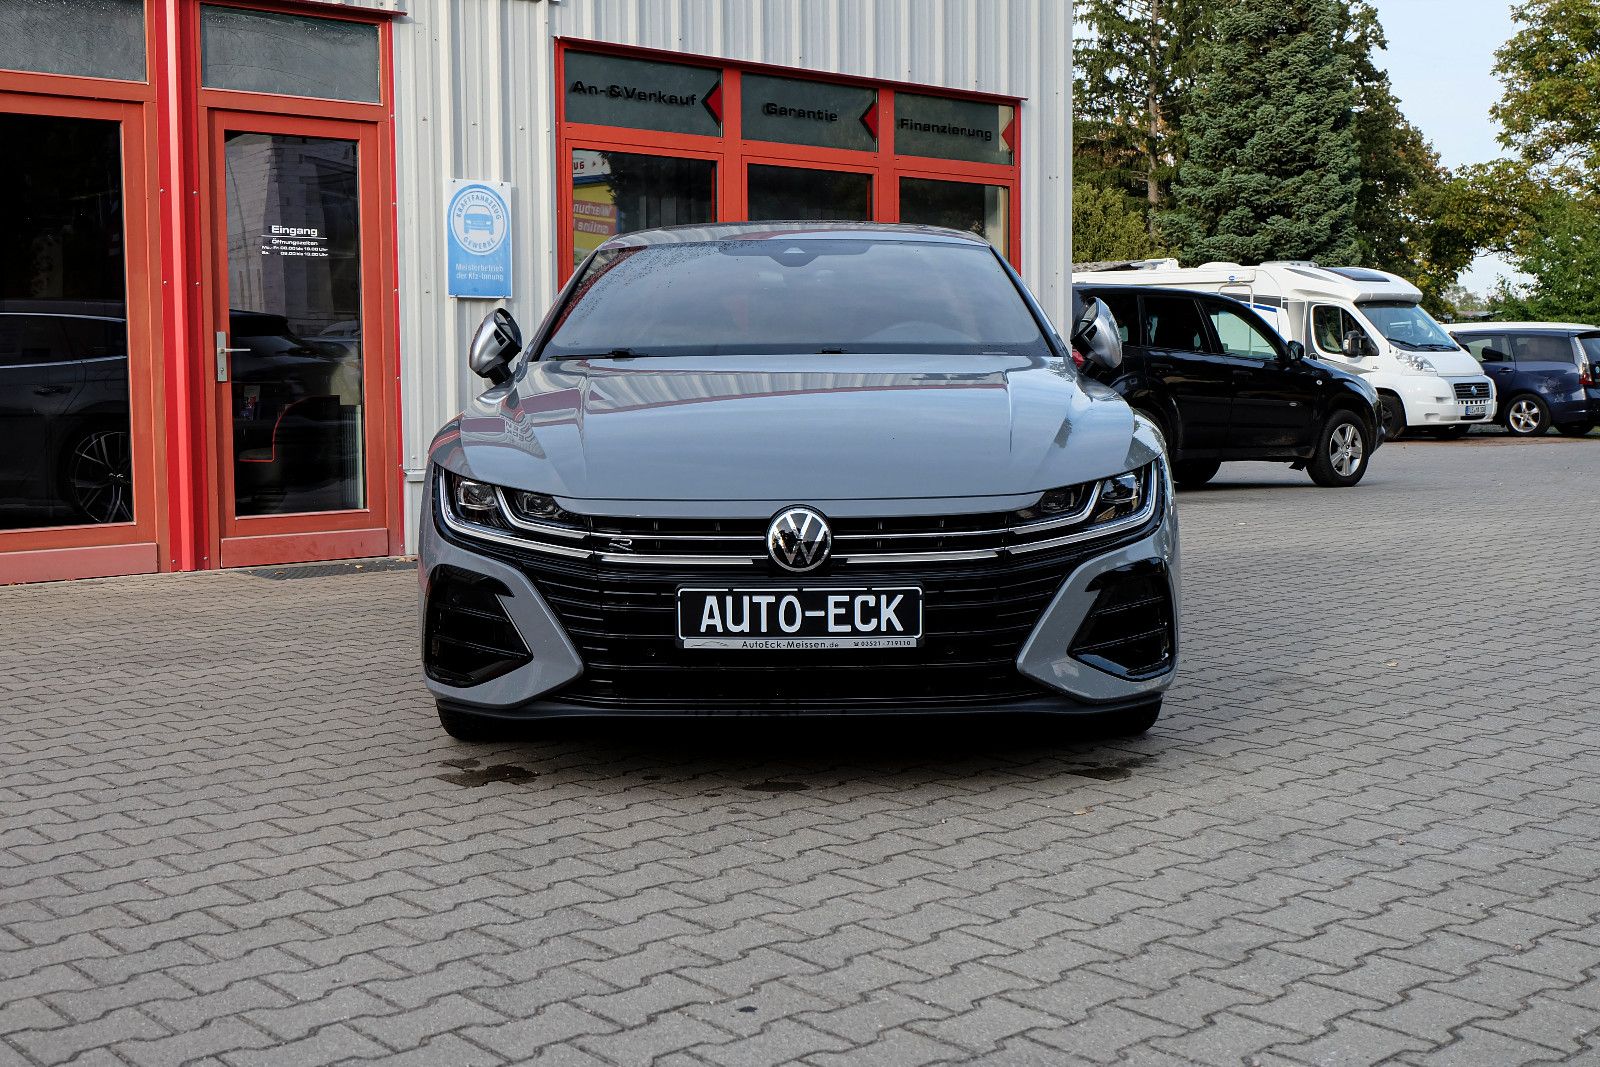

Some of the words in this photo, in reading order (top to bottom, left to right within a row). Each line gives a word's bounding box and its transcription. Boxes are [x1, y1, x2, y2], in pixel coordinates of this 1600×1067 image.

[763, 102, 838, 122] Garantie
[900, 118, 993, 141] Finanzierung
[456, 194, 502, 220] KRAFTFAHRZEUG
[272, 225, 318, 236] Eingang
[463, 236, 496, 249] GEWERBE
[455, 263, 504, 272] Meisterbetrieb
[468, 272, 504, 281] Kfz-Innung
[700, 594, 904, 633] AUTO-ECK
[741, 640, 839, 649] AutoEck-Meissen.de
